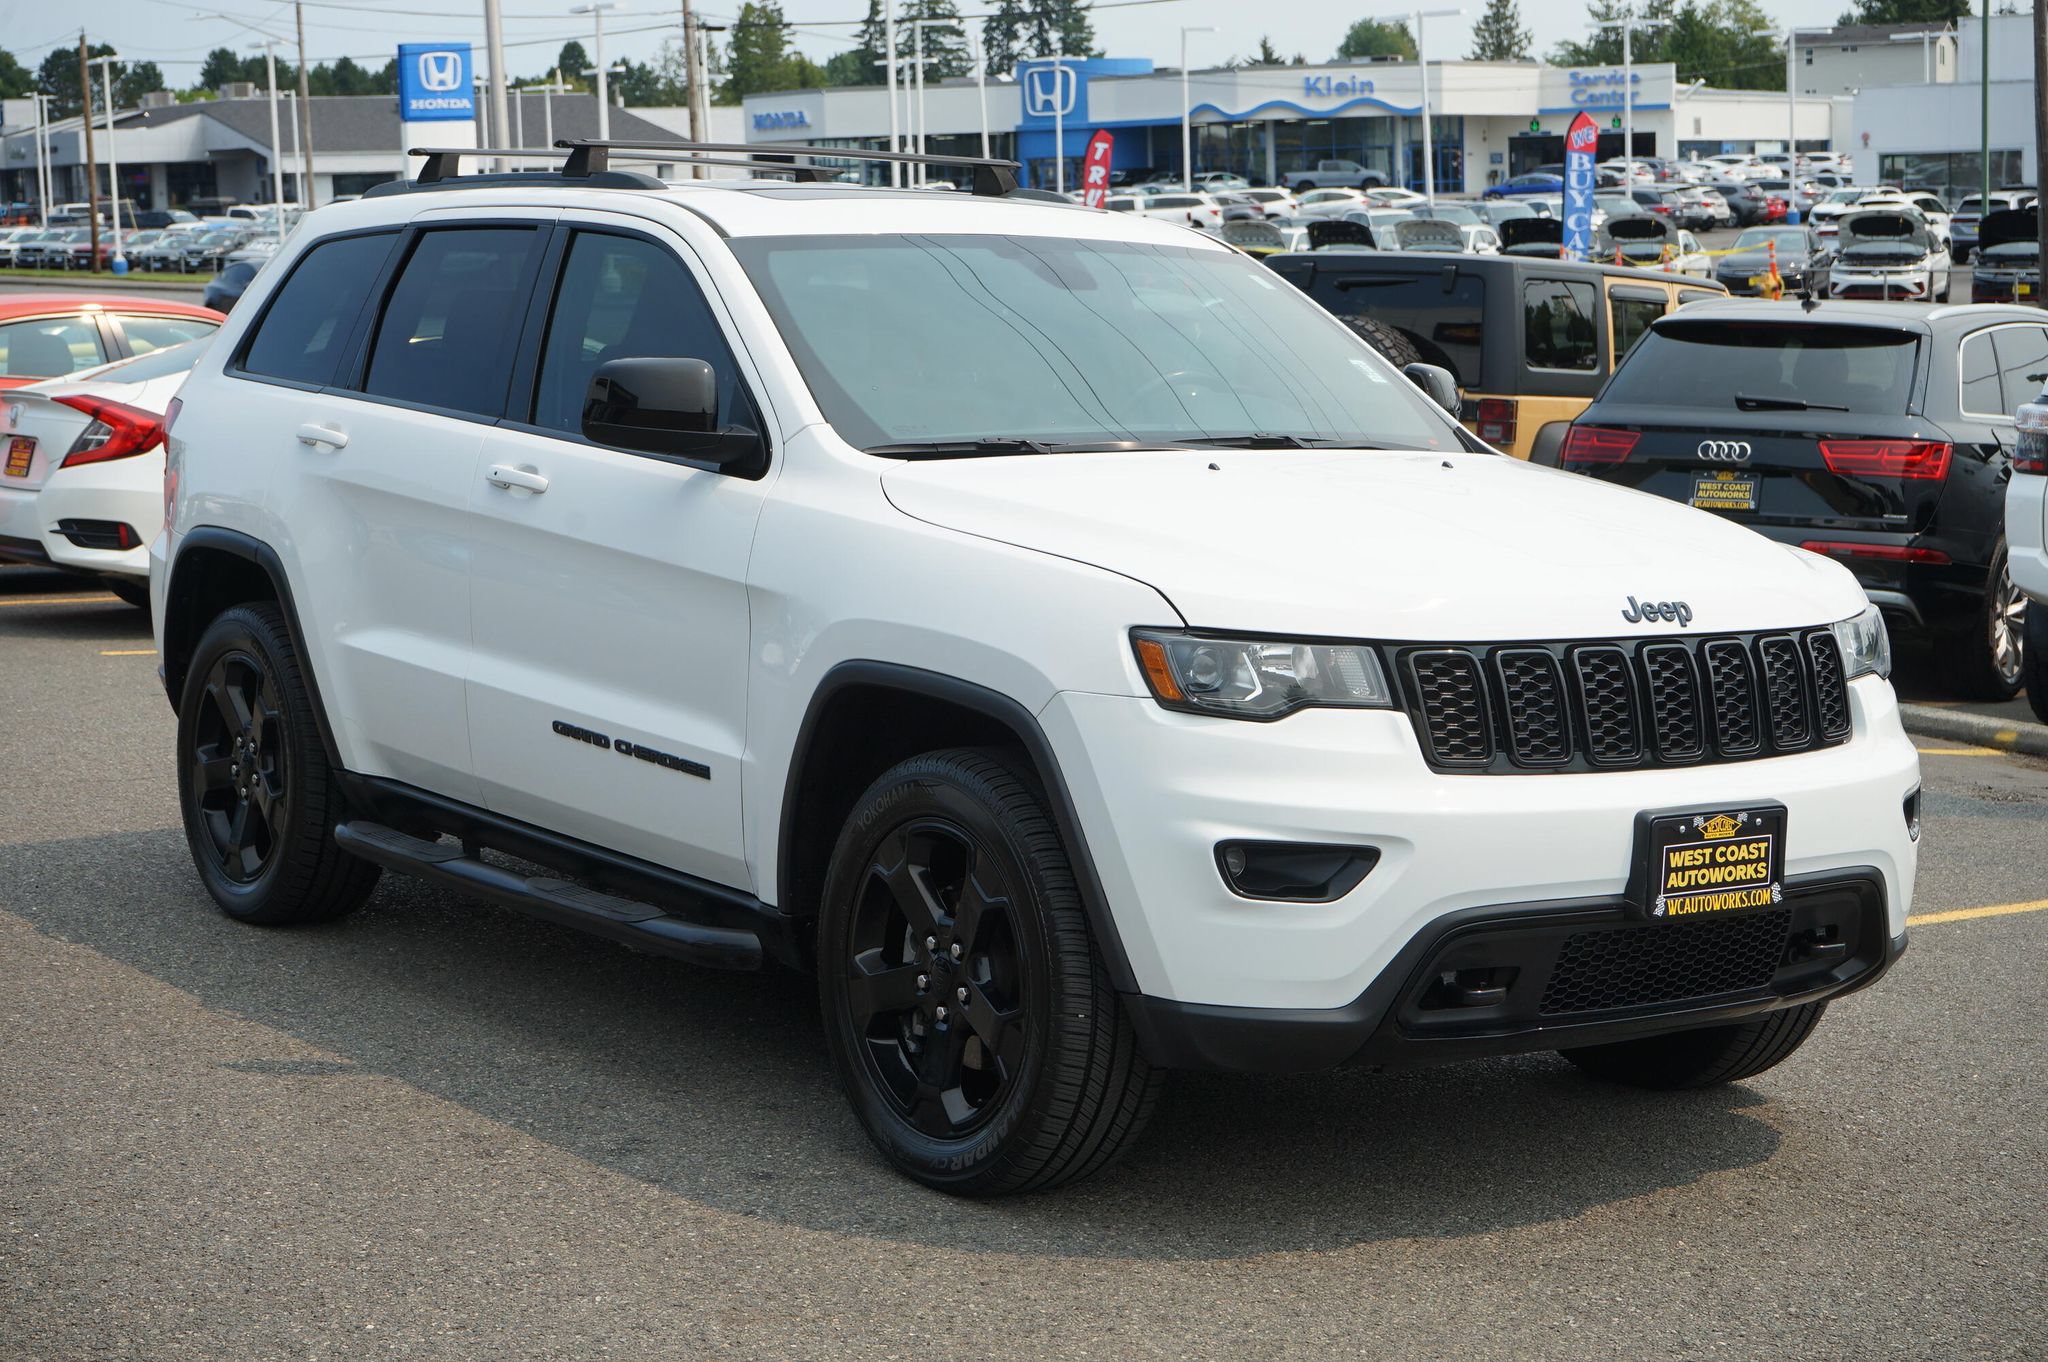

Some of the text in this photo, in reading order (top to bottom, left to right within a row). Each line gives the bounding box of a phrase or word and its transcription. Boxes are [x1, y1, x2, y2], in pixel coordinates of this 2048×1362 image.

[1304, 75, 1375, 97] Klein
[1568, 70, 1641, 87] Service
[409, 98, 472, 110] HONDA
[1571, 126, 1596, 149] WE
[1568, 152, 1592, 208] BUY
[1697, 490, 1750, 499] AUTOWORKS
[1699, 482, 1752, 492] WEST COAST
[1621, 595, 1693, 628] Jeep
[551, 720, 711, 780] GRAND CHEROKEE
[1669, 842, 1768, 868] WEST COAST
[1667, 862, 1768, 889] AUTOWORKS
[1667, 888, 1771, 916] WCAUTOWORKS.COM
